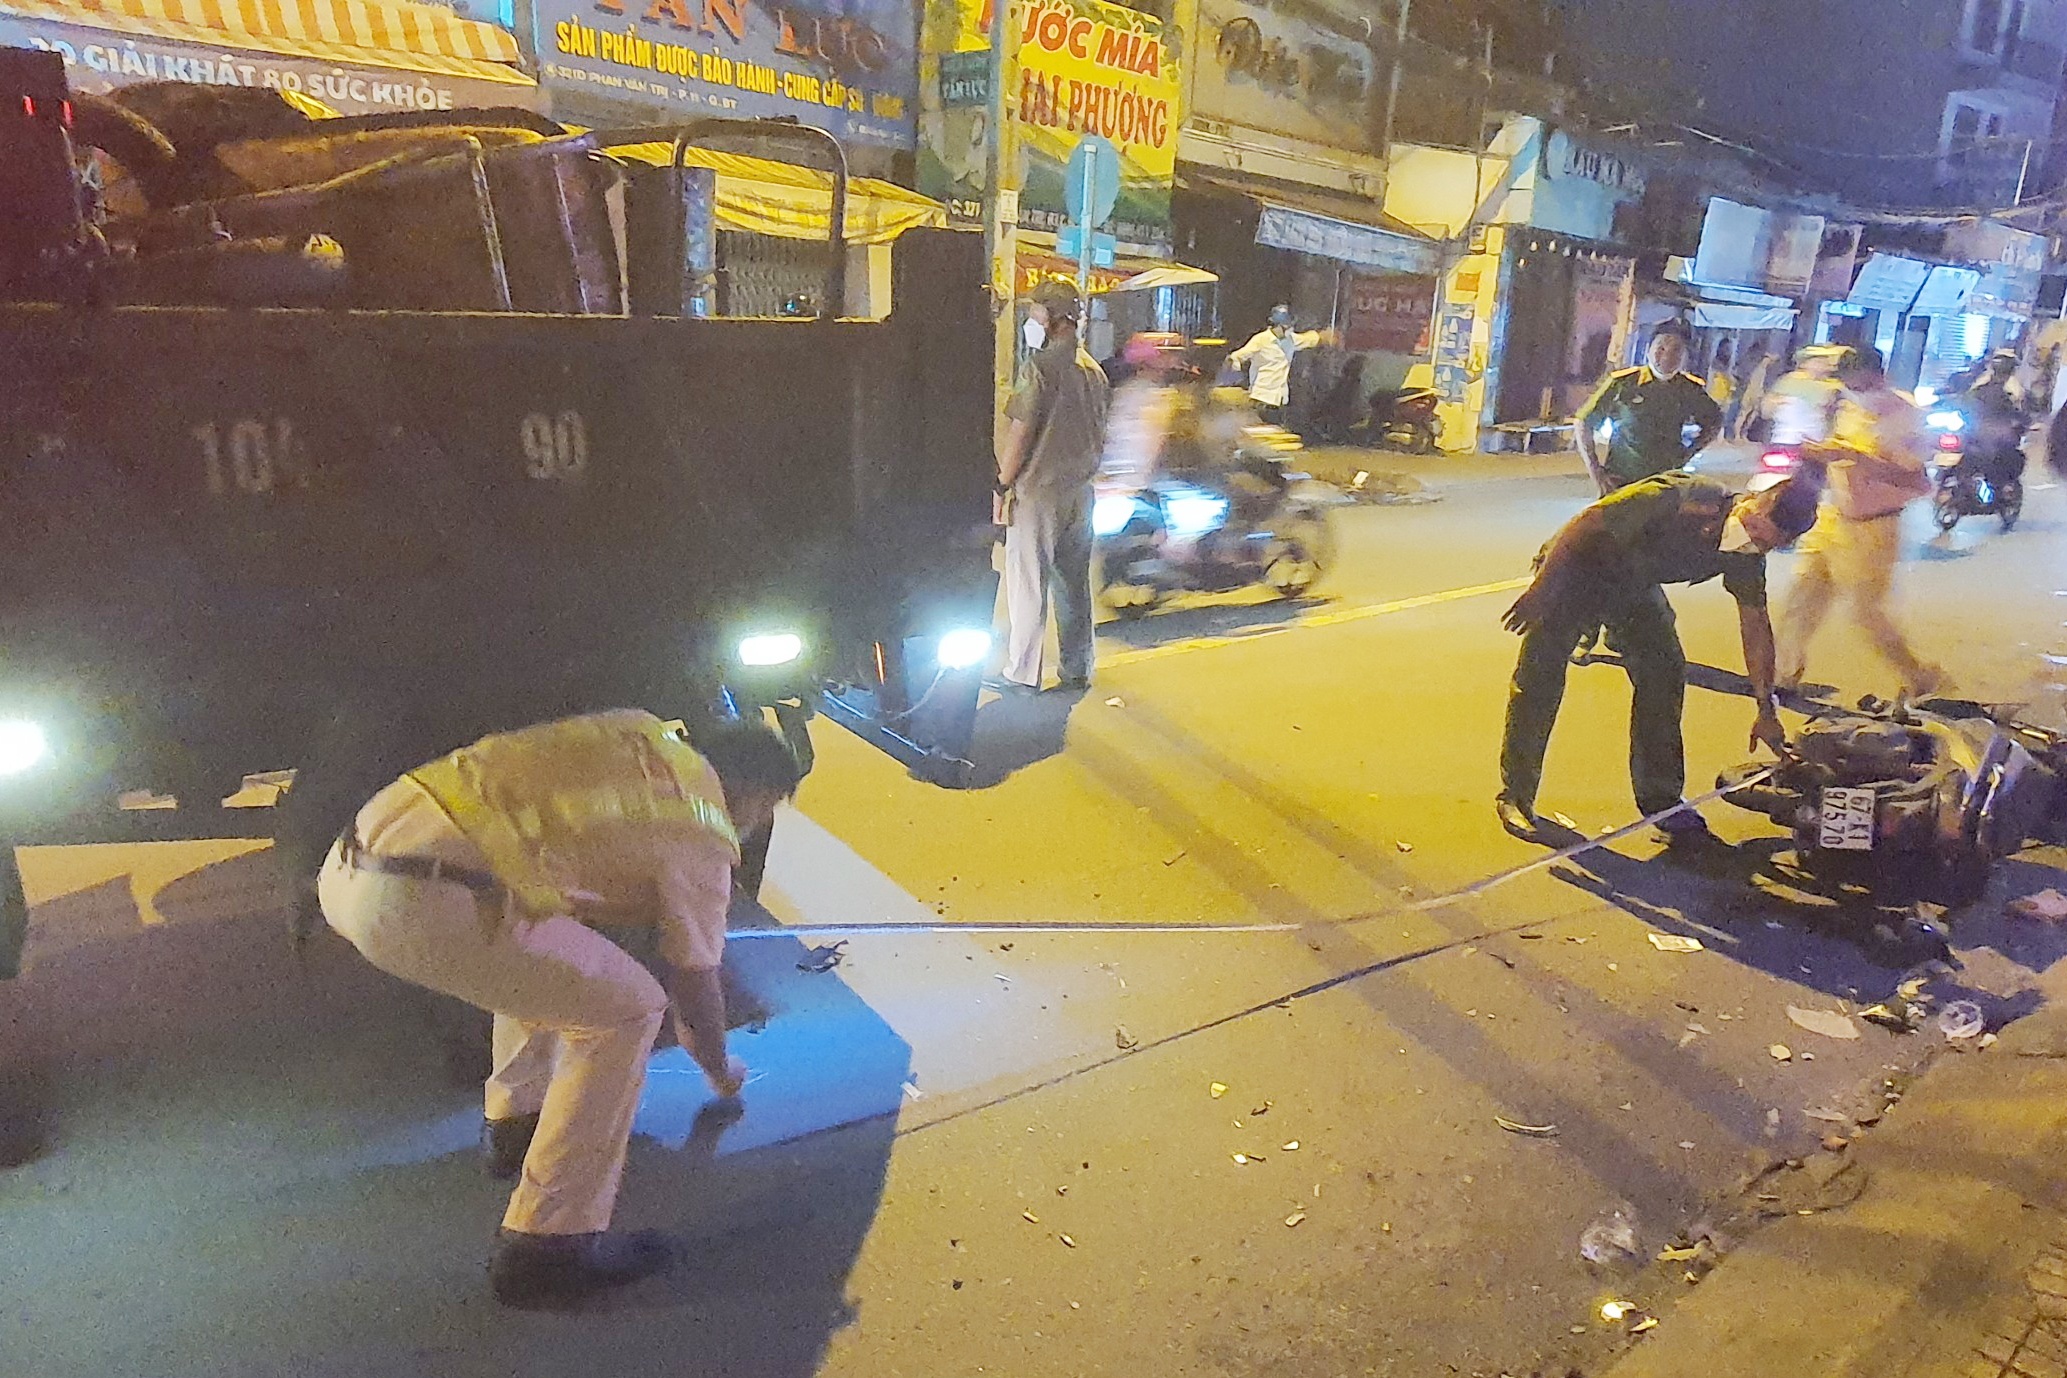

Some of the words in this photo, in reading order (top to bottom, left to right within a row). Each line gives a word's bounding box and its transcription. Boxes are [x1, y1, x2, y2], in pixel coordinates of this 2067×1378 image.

[29, 36, 77, 67] O
[83, 39, 159, 78] GIẢI
[161, 53, 256, 88] KHÁT
[306, 68, 366, 102] SỨC
[370, 76, 454, 111] KHỎE
[556, 14, 596, 58] SẢN
[600, 23, 652, 70] PHẨM
[655, 44, 699, 84] ĐƯỢC
[702, 46, 732, 86] BẢO
[1095, 24, 1160, 78] MÍA
[520, 411, 588, 480] 90
